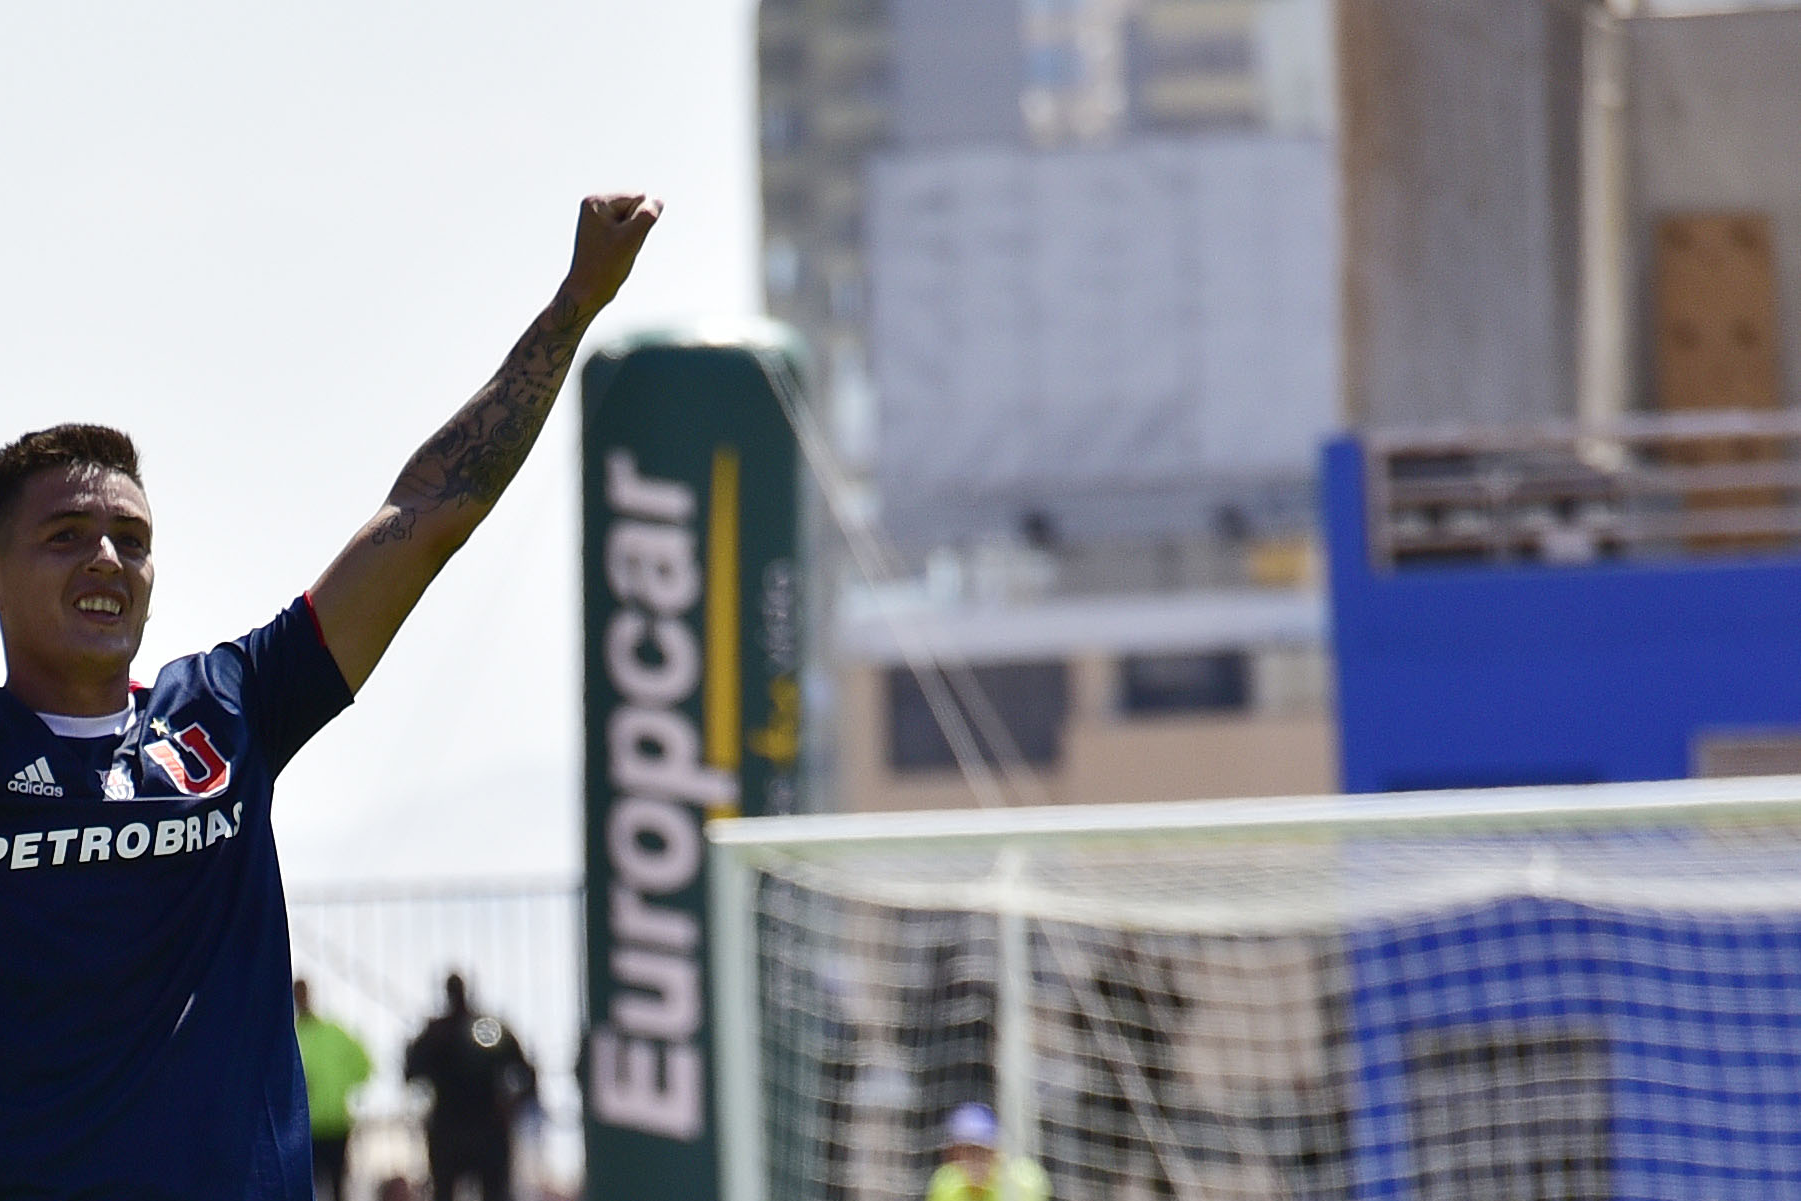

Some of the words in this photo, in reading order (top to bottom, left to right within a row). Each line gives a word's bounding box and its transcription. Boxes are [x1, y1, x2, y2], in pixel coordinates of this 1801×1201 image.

[7, 778, 64, 798] adidas
[144, 721, 231, 799] U
[594, 448, 741, 1141] Europcar
